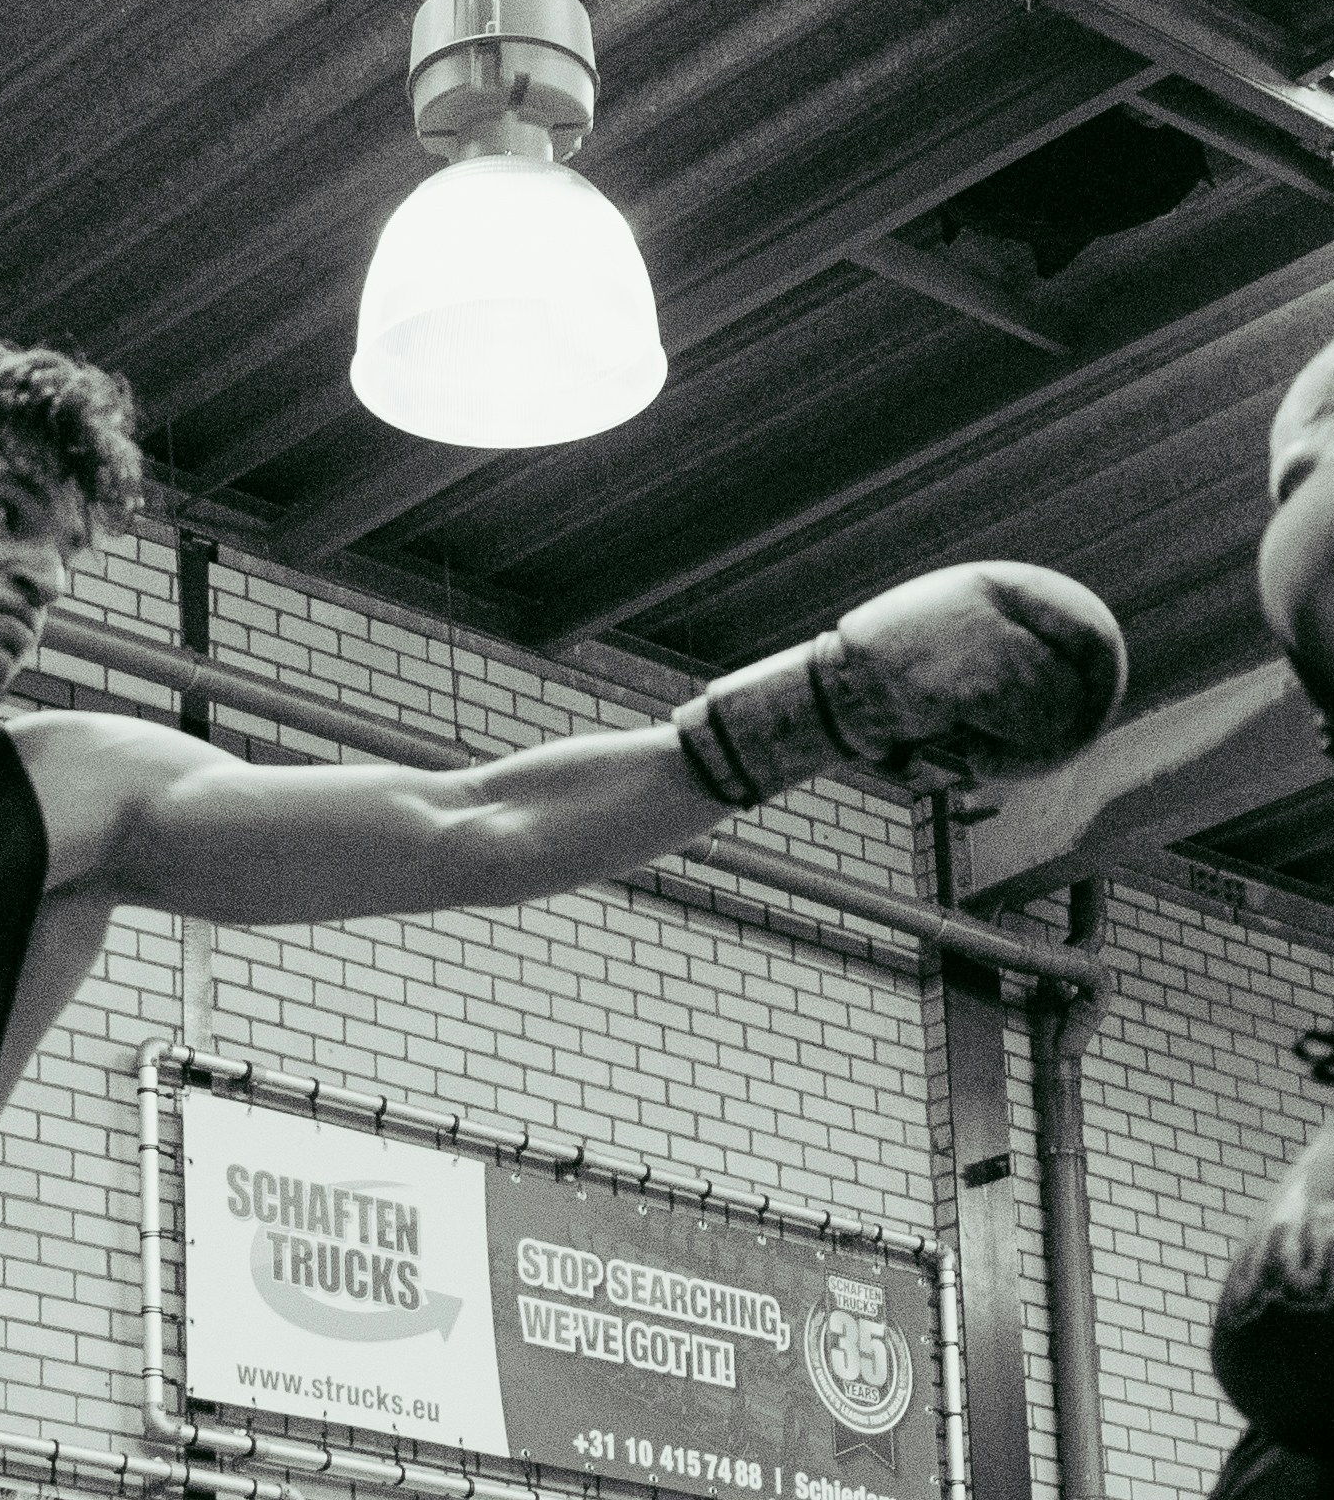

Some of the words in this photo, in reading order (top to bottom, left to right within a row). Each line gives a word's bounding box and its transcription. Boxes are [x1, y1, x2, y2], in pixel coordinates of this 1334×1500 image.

[226, 1163, 419, 1257] SCHAFTEN
[267, 1231, 421, 1311] TRUCKS
[519, 1239, 603, 1297] STOP
[607, 1260, 790, 1350] SEARCHING,
[829, 1276, 883, 1304] SCHAFTEN
[835, 1293, 879, 1317] TRUCKS
[518, 1295, 624, 1363] WE'VE
[625, 1322, 691, 1377] GOT
[692, 1335, 736, 1387] IT!
[829, 1310, 887, 1386] 35
[236, 1363, 441, 1423] www.strucks.eu
[843, 1381, 880, 1404] YEARS
[572, 1429, 616, 1461] +31
[625, 1436, 654, 1468] 10
